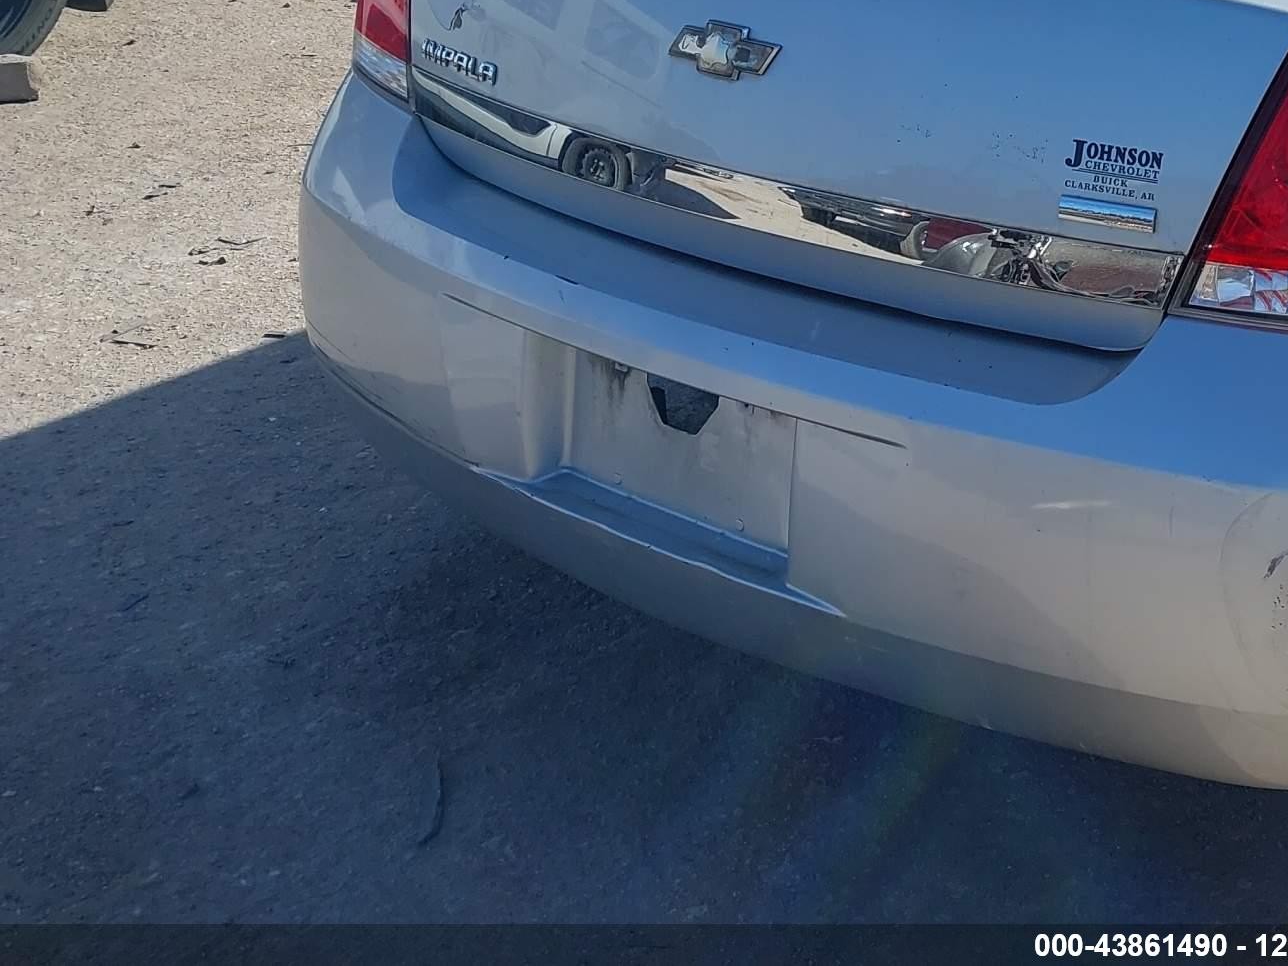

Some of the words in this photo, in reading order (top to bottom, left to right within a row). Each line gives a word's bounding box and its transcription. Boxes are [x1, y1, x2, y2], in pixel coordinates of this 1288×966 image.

[421, 37, 498, 87] IMPALA
[1065, 138, 1164, 170] JOHNSON
[1085, 160, 1160, 180] CHEVROLET
[1093, 175, 1128, 187] BUICK
[1064, 179, 1138, 200] CLARKSVILLE,
[1140, 191, 1155, 202] AR
